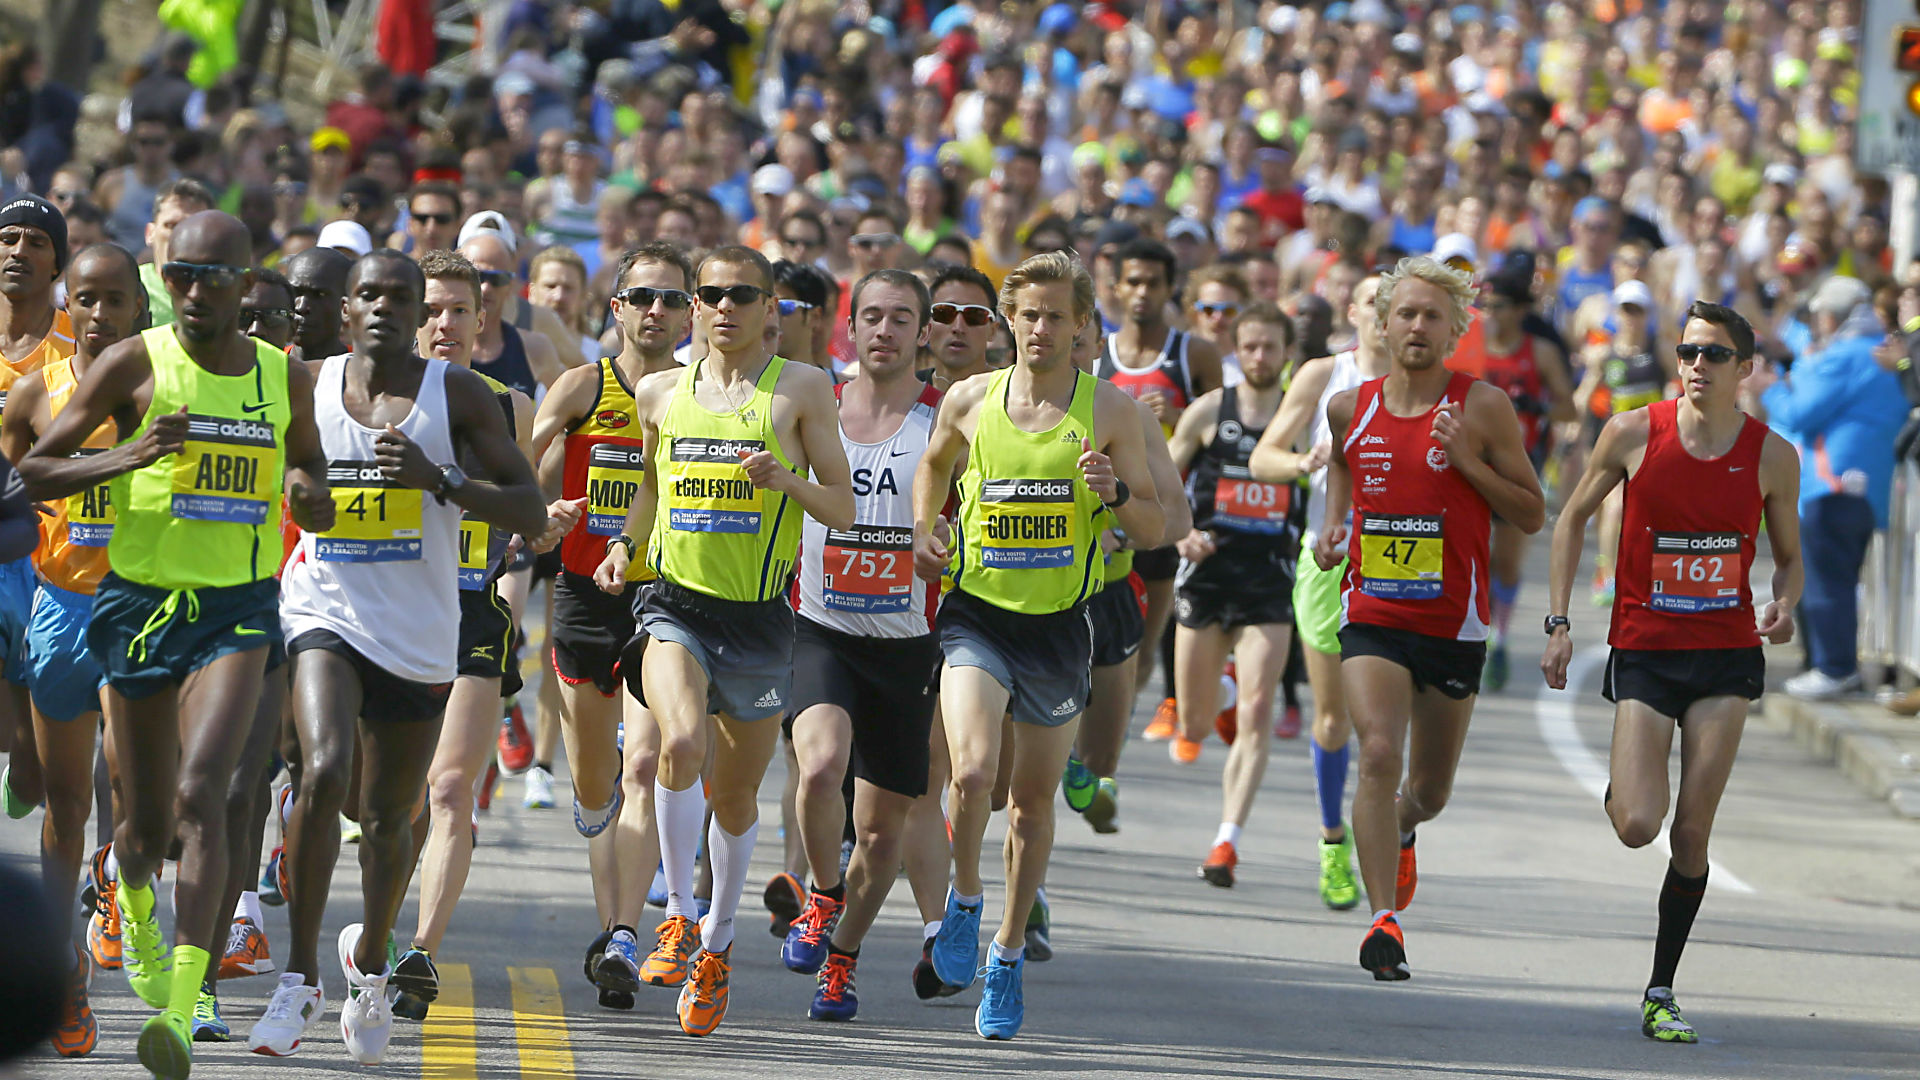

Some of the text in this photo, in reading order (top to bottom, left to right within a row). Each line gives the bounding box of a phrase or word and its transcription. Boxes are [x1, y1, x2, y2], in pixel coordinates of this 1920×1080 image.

[220, 420, 273, 440] adidas
[194, 453, 258, 494] ABDI
[852, 467, 898, 496] SA
[590, 479, 638, 508] MOR
[675, 477, 754, 500] EGGLESTON
[1017, 482, 1070, 496] adidas
[1234, 482, 1276, 507] 103
[81, 485, 110, 518] AP
[345, 491, 387, 521] 41
[861, 530, 912, 544] adidas
[987, 514, 1068, 540] GOTCHER
[1390, 518, 1439, 532] adidas
[1382, 539, 1418, 565] 47
[1690, 536, 1737, 549] adidas
[840, 549, 896, 579] 752
[1672, 556, 1724, 582] 162
[826, 574, 831, 587] 1
[754, 698, 782, 708] adidas
